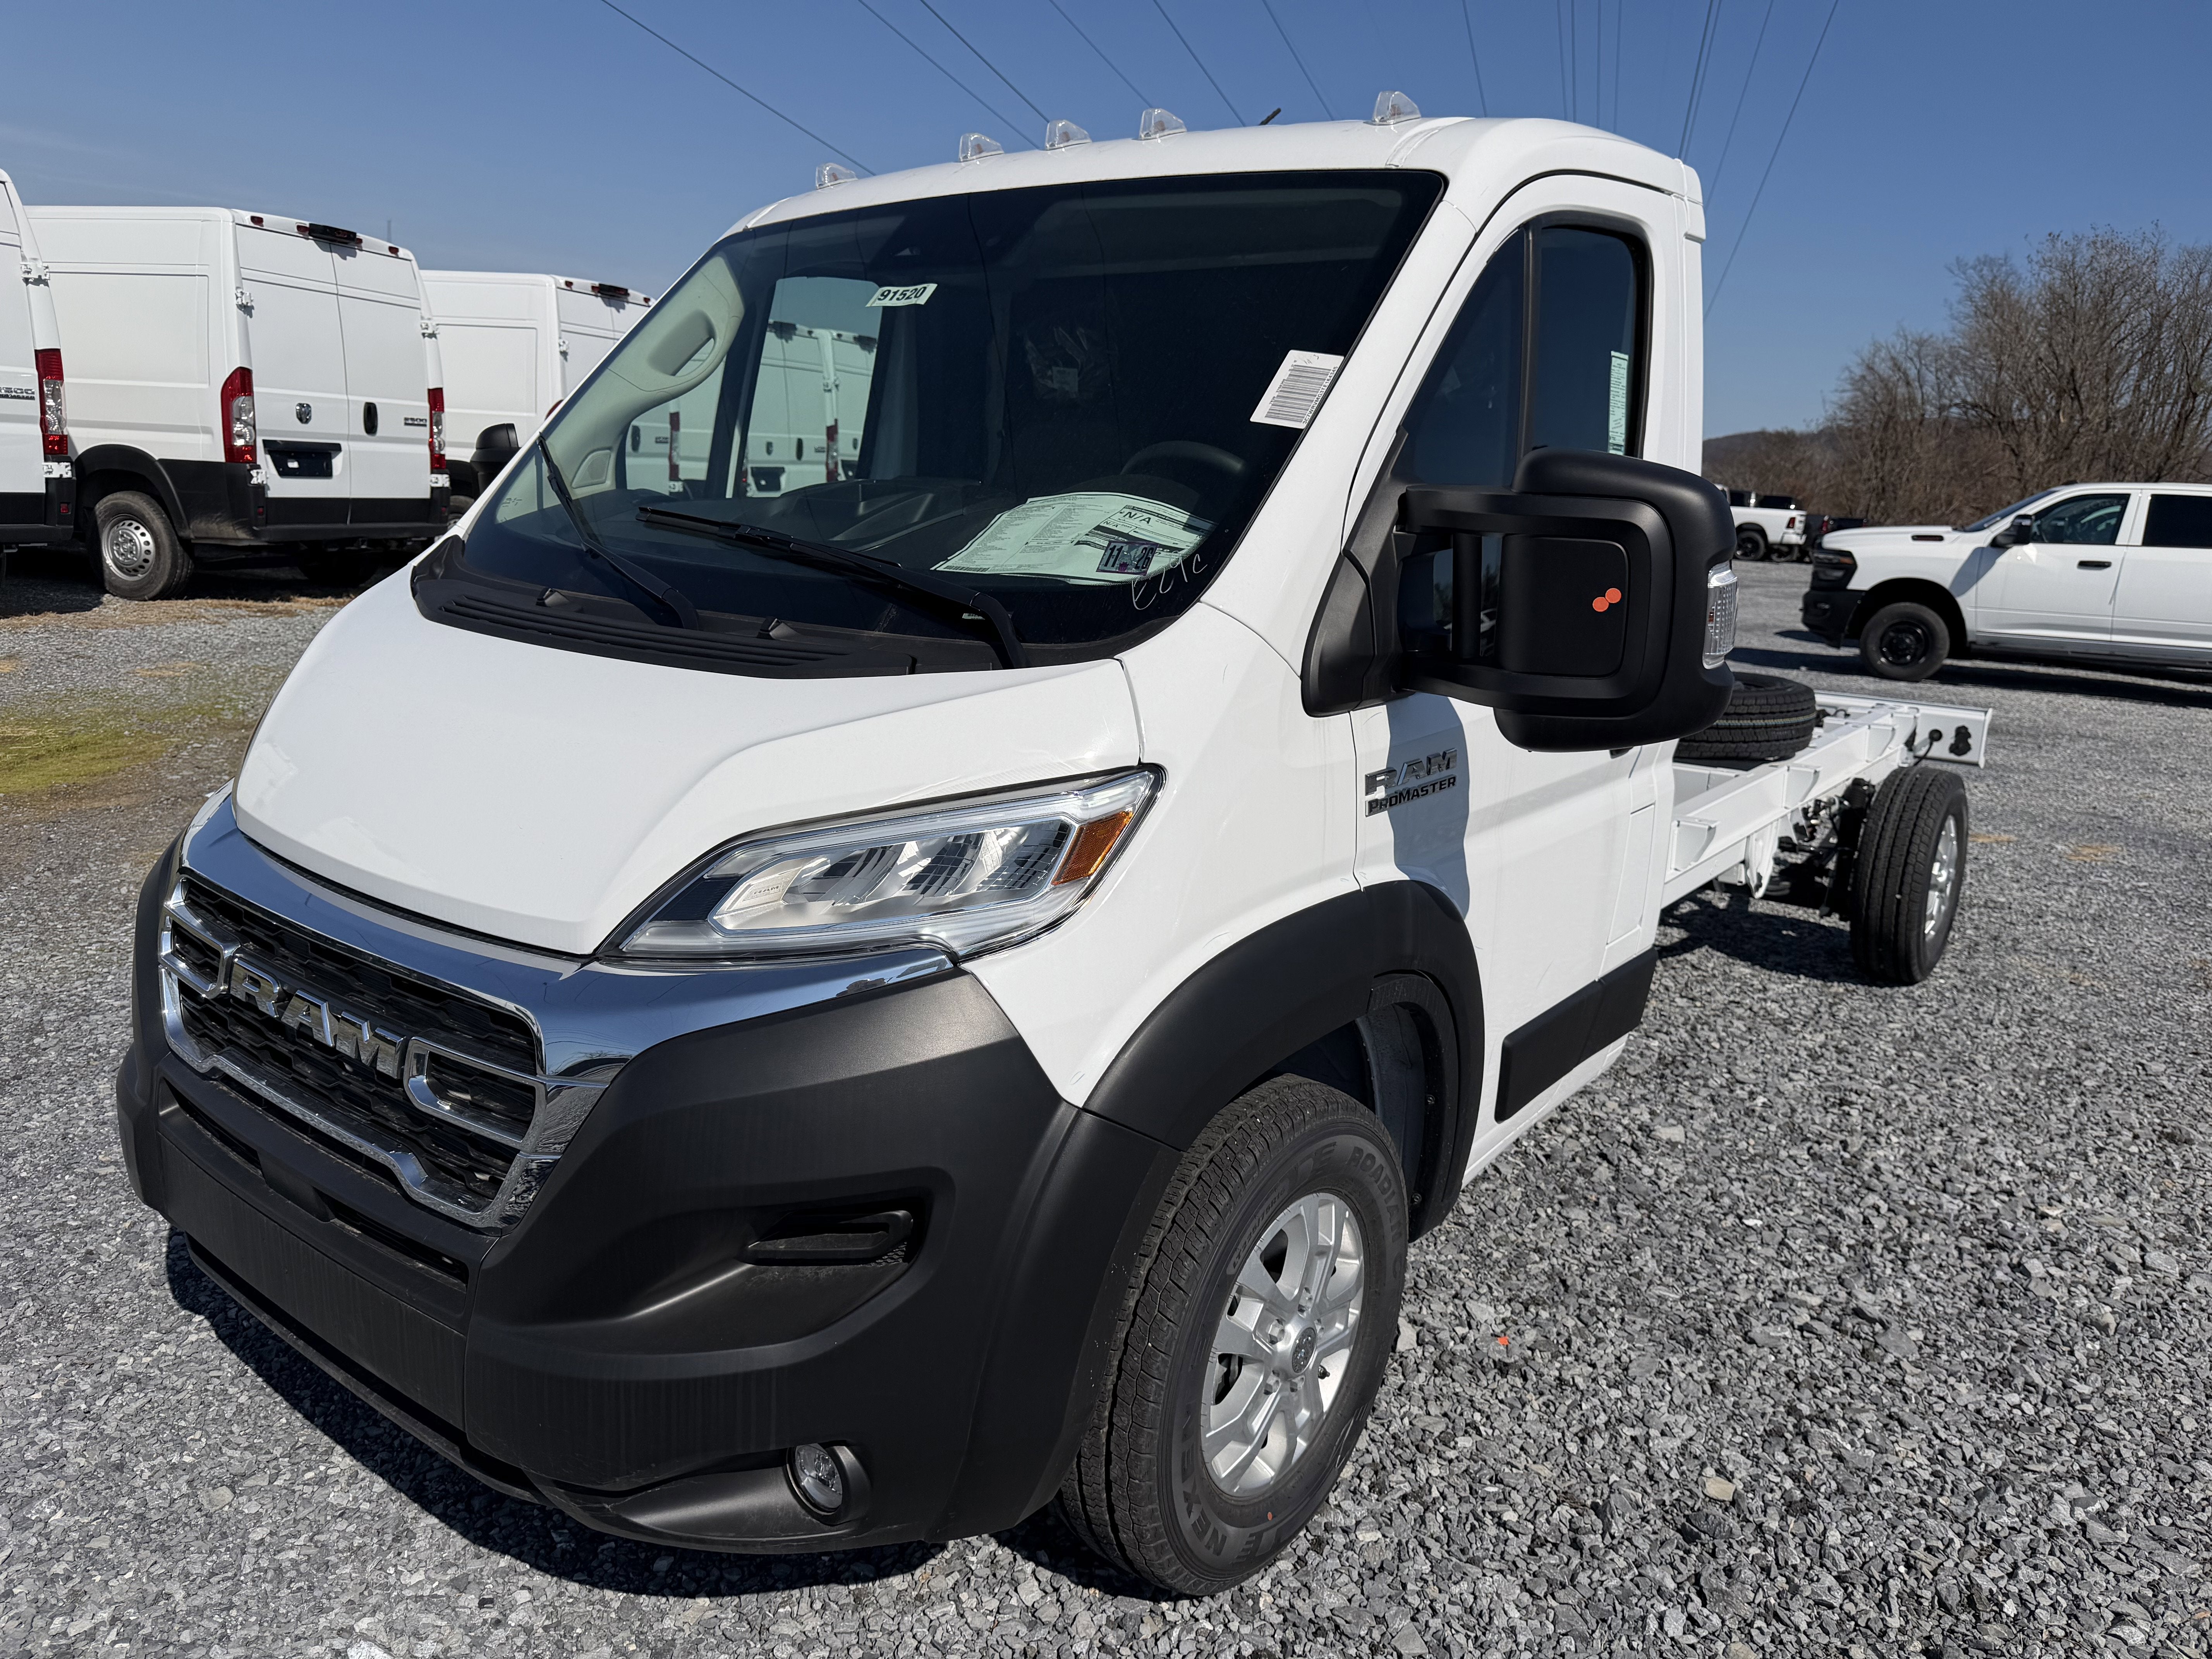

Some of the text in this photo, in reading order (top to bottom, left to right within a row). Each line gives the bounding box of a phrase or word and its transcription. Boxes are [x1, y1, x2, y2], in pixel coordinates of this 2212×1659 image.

[877, 286, 927, 301] 91520
[1123, 511, 1152, 524] N/A
[1103, 545, 1124, 568] 11
[1134, 546, 1155, 570] 26
[1364, 747, 1457, 796] RAM
[1368, 775, 1456, 813] PROMASTER
[230, 958, 406, 1079] RAM
[1346, 1146, 1403, 1244] ROADIAN
[1181, 1396, 1227, 1557] NEXEN
